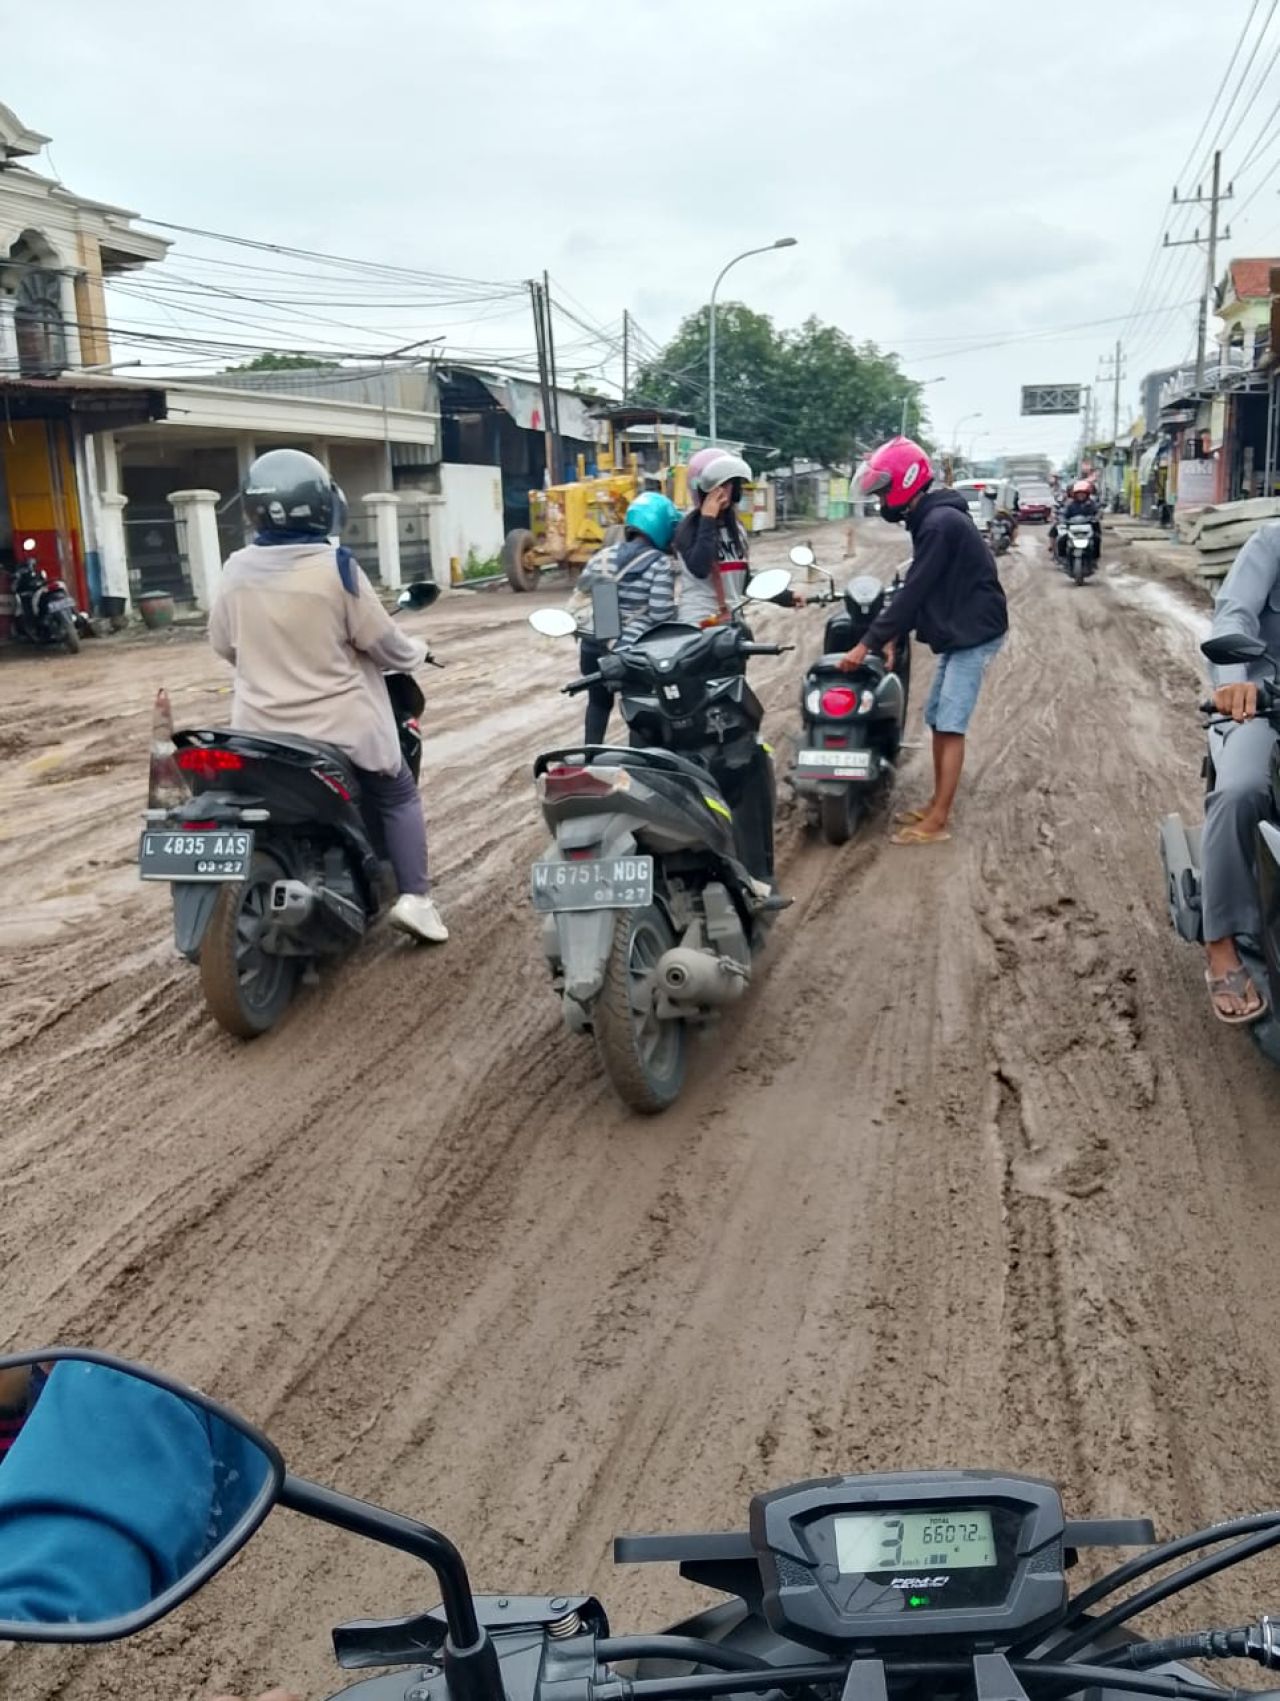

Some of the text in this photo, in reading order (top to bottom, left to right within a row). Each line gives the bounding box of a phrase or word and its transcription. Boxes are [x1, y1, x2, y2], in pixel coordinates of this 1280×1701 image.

[145, 836, 247, 856] L 4835 AAS
[535, 861, 648, 887] W 6751 NDG
[879, 1519, 905, 1568] 3
